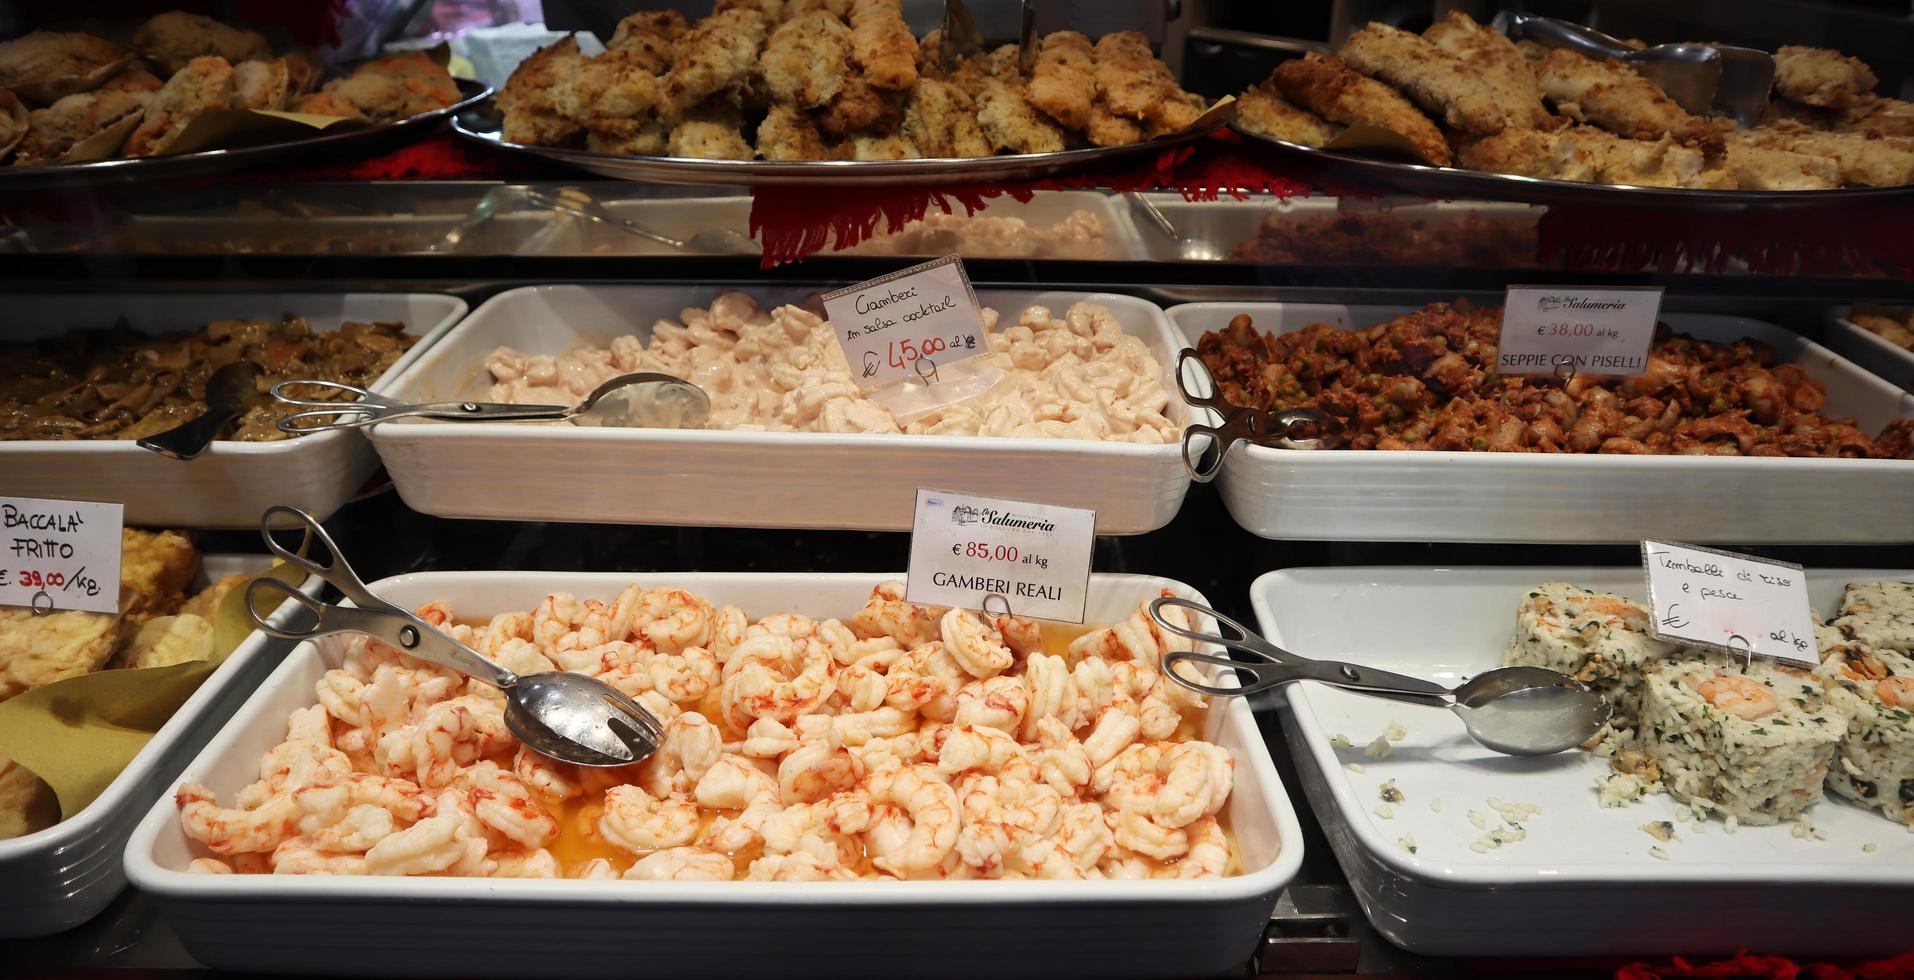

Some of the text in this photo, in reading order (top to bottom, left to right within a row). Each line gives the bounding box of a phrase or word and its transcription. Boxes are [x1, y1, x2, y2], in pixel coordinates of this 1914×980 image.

[1563, 297, 1627, 310] Salumeria
[847, 295, 956, 341] in salsa cocktail
[1537, 323, 1619, 339] € 38,00 al kg
[862, 350, 880, 378] €
[949, 335, 962, 348] al
[1501, 354, 1642, 368] SEPPIE CON PISELLI
[981, 510, 1056, 532] Salumeria
[10, 538, 74, 559] FRITTO
[952, 541, 1048, 569] € 85,00 al kg
[1651, 551, 1792, 587] Timballi di riso
[932, 571, 1062, 601] GAMBERI REALI
[1682, 583, 1744, 600] e pesce
[1662, 603, 1690, 629] €
[1770, 630, 1789, 643] al
